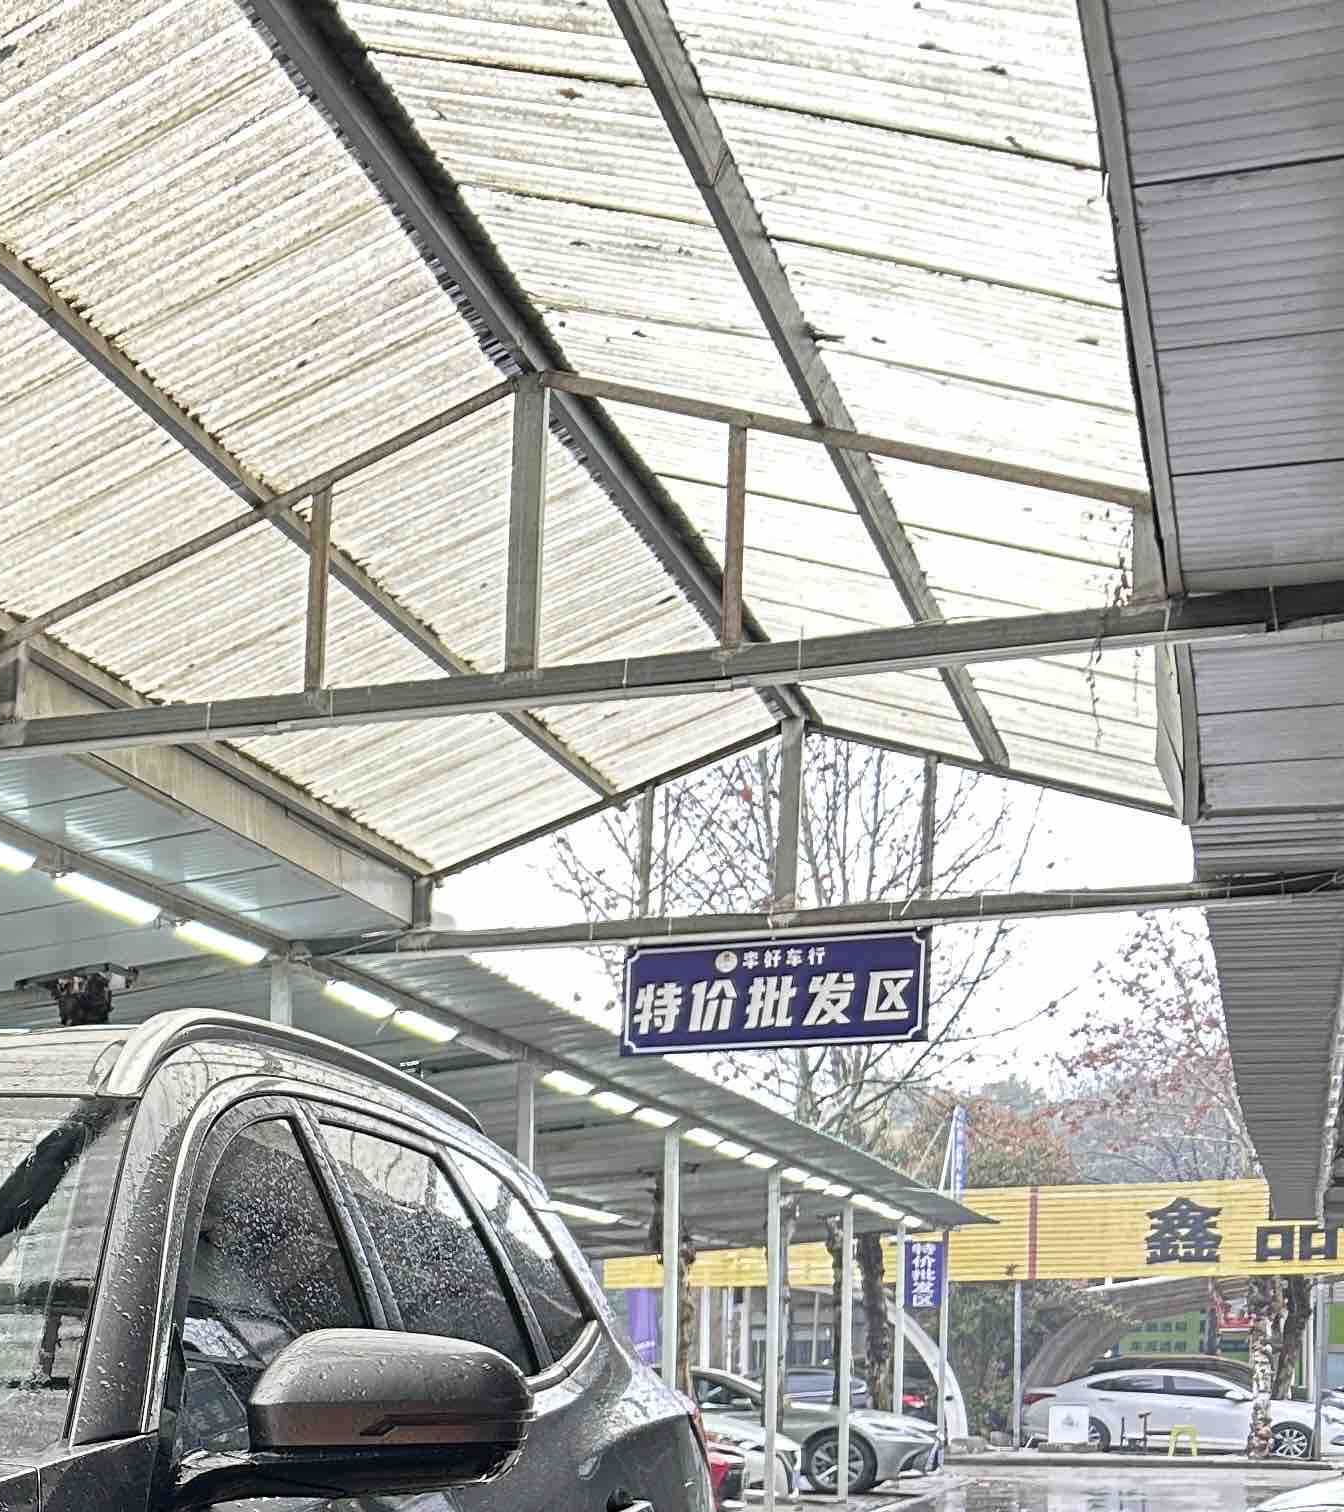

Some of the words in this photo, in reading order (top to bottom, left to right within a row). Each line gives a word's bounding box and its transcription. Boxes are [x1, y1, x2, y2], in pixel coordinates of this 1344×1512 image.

[632, 968, 915, 1035] 特价批发区
[911, 1242, 937, 1308] 特价批发区
